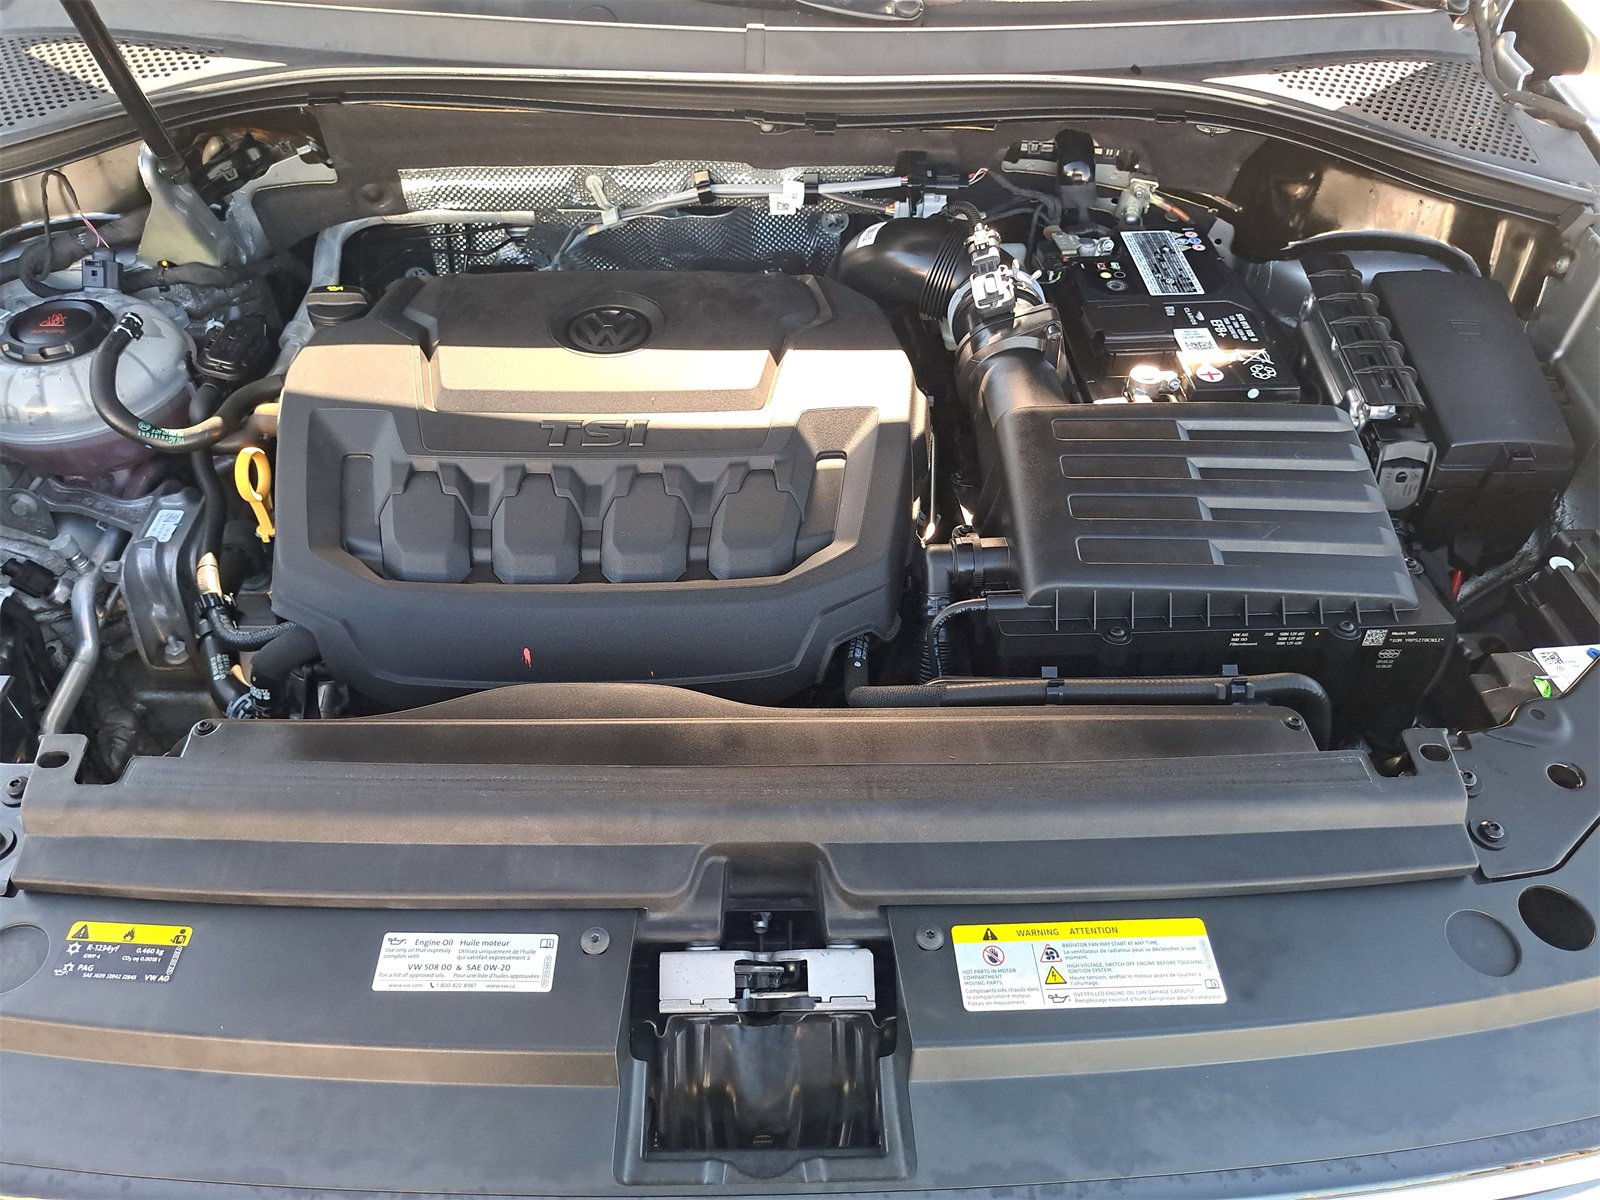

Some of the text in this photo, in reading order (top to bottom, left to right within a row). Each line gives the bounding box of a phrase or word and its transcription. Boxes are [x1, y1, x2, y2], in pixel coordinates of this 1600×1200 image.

[1183, 307, 1198, 326] CLARIOS
[1210, 319, 1228, 338] EFB+
[539, 419, 650, 447] TSI
[1016, 926, 1118, 937] WARNING ATTENTION
[414, 939, 441, 947] Engine
[460, 939, 480, 947] Huile
[86, 944, 120, 954] R-1234yf
[156, 948, 164, 956] kg
